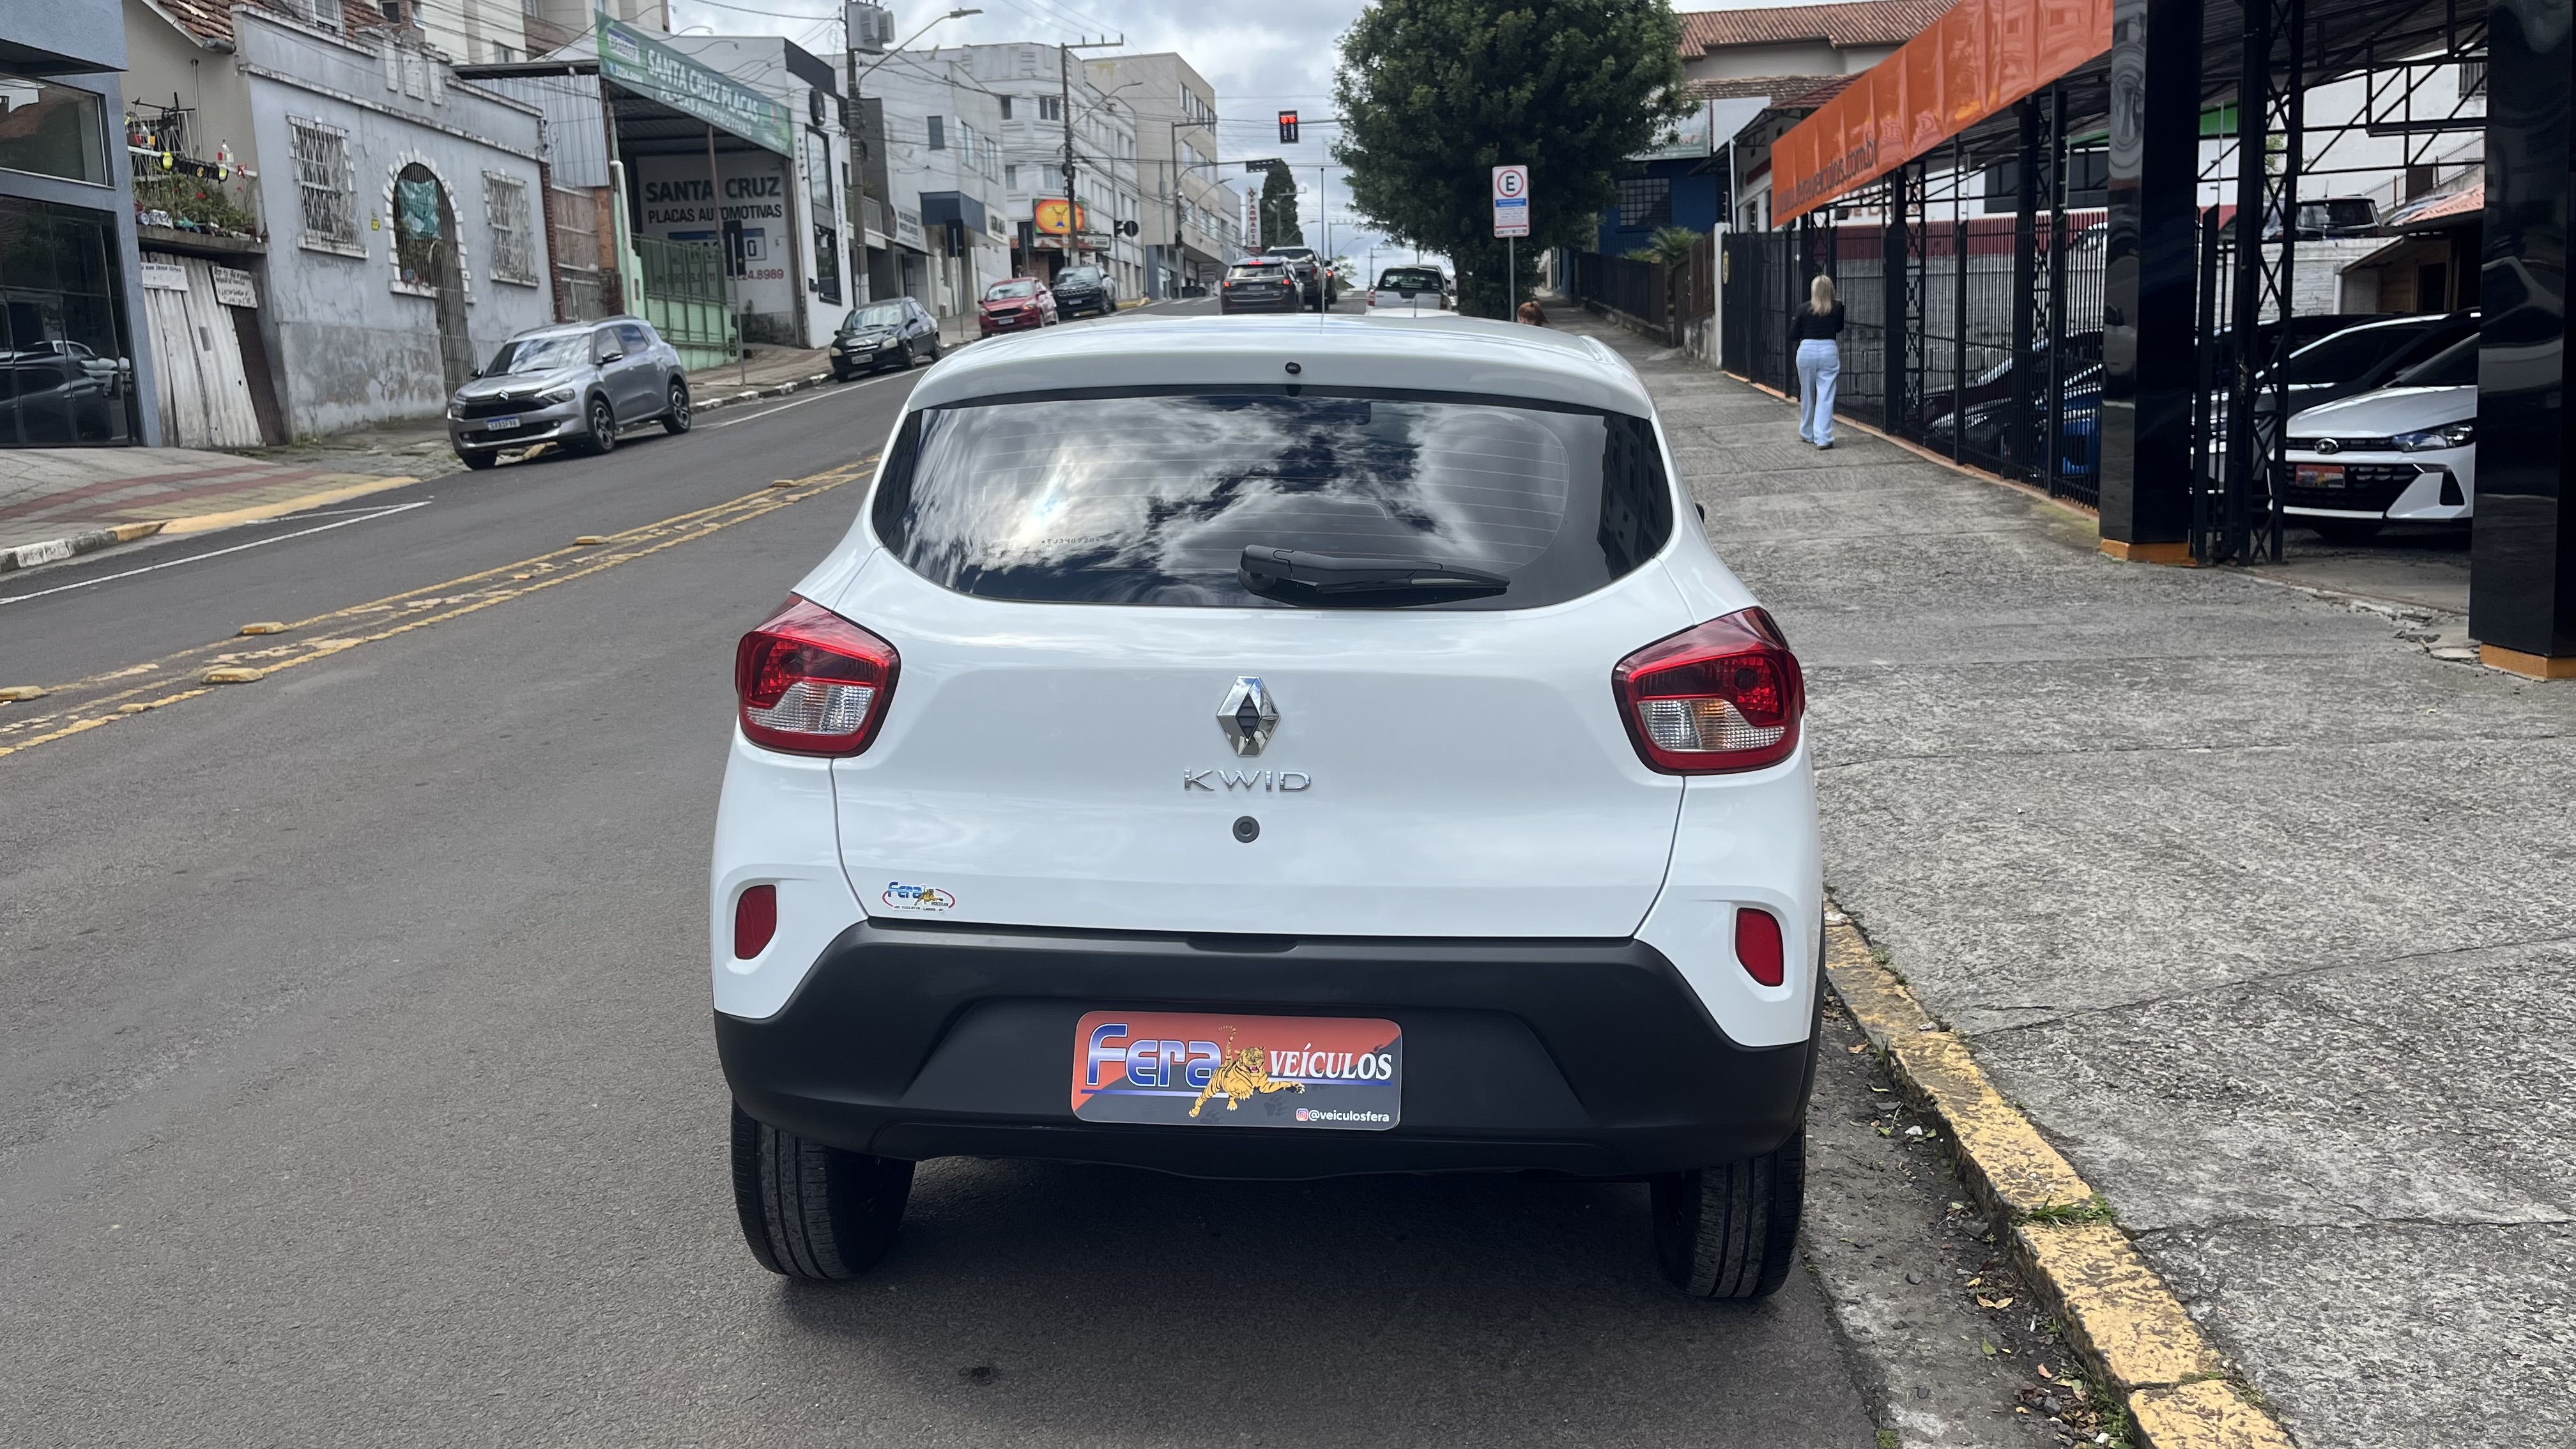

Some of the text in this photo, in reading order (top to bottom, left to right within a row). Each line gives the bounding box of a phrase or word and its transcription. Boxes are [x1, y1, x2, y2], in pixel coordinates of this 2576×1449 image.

[647, 49, 687, 91] SANTA
[689, 69, 721, 103] CRUZ
[721, 84, 759, 123] PLACAS
[660, 86, 753, 136] PLACAS AUTOMOTIVAS
[645, 176, 781, 203] SANTA CRUZ
[1506, 176, 1515, 192] E
[648, 204, 783, 224] PLACAS AUOMOTIVAS
[1249, 198, 1257, 245] FARMACIA
[1184, 769, 1311, 792] KWID
[1269, 1043, 1393, 1081] VEÍCULOS
[1308, 1109, 1390, 1122] @veiculosfera
